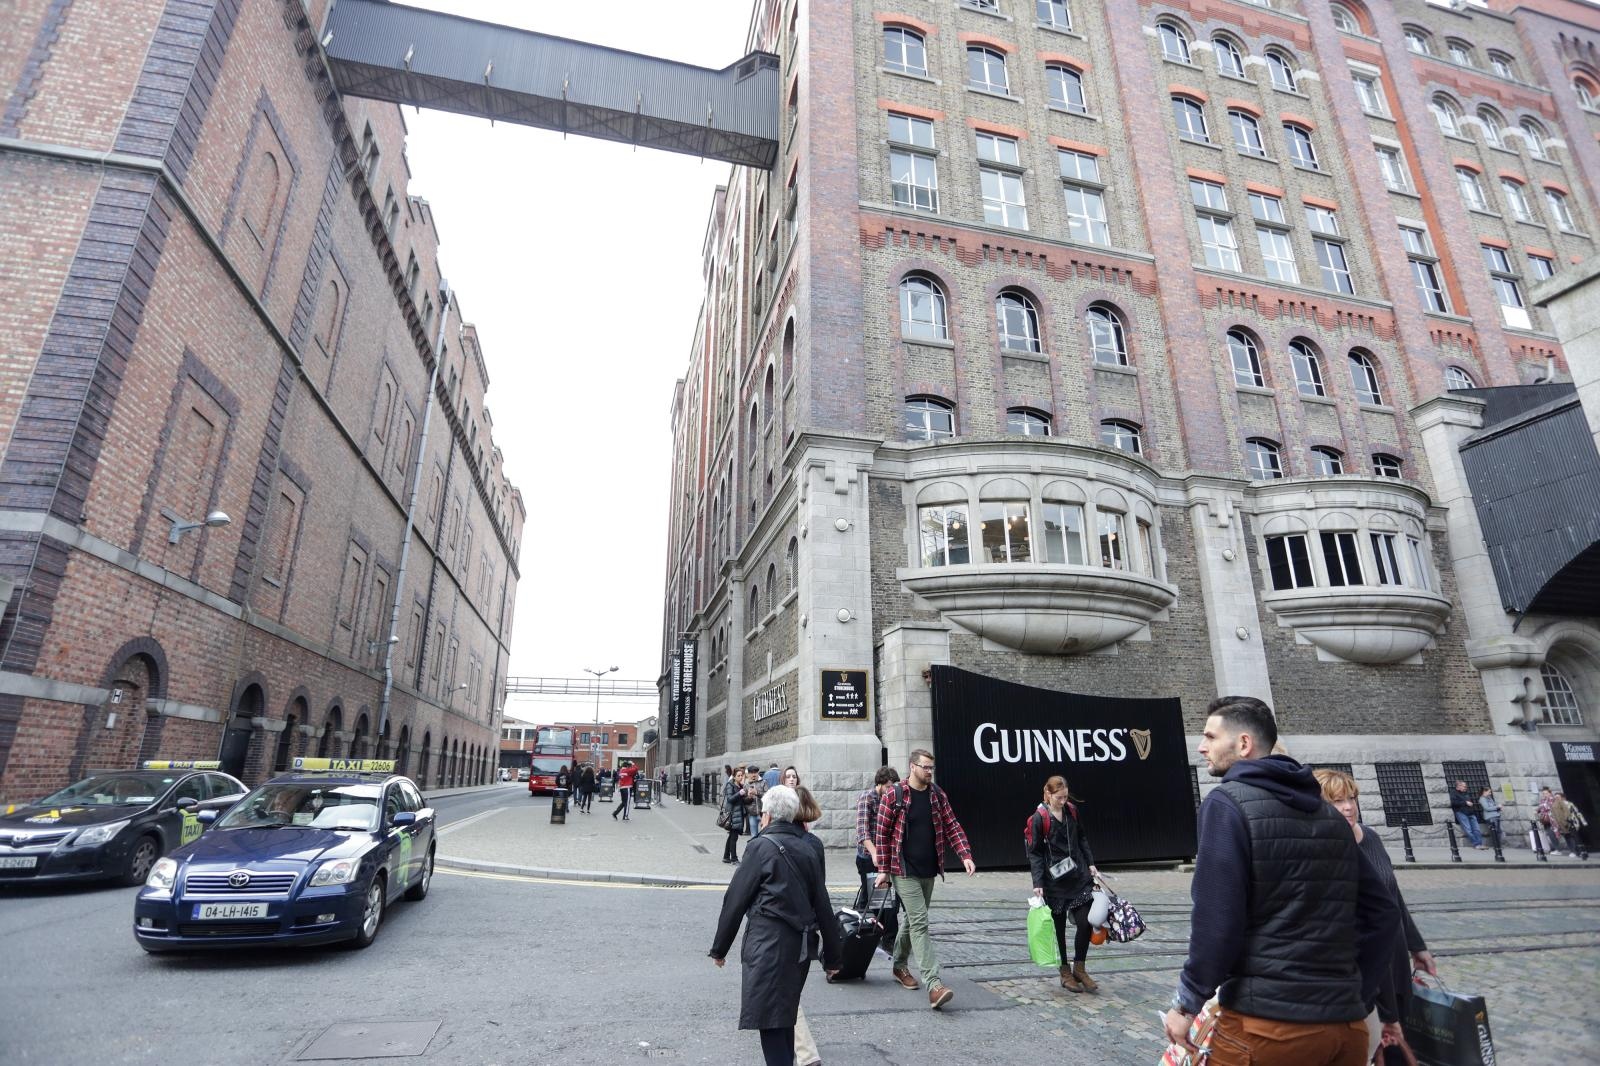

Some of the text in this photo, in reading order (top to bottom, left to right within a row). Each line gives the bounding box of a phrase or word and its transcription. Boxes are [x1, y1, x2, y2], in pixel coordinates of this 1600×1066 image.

[683, 644, 694, 693] STOREHOUSE
[753, 683, 788, 722] GUINNESS
[973, 722, 1127, 763] GUINNESS
[332, 760, 391, 771] TAXI 22606
[185, 824, 201, 836] TAXI
[205, 905, 260, 918] 04-LH-1415
